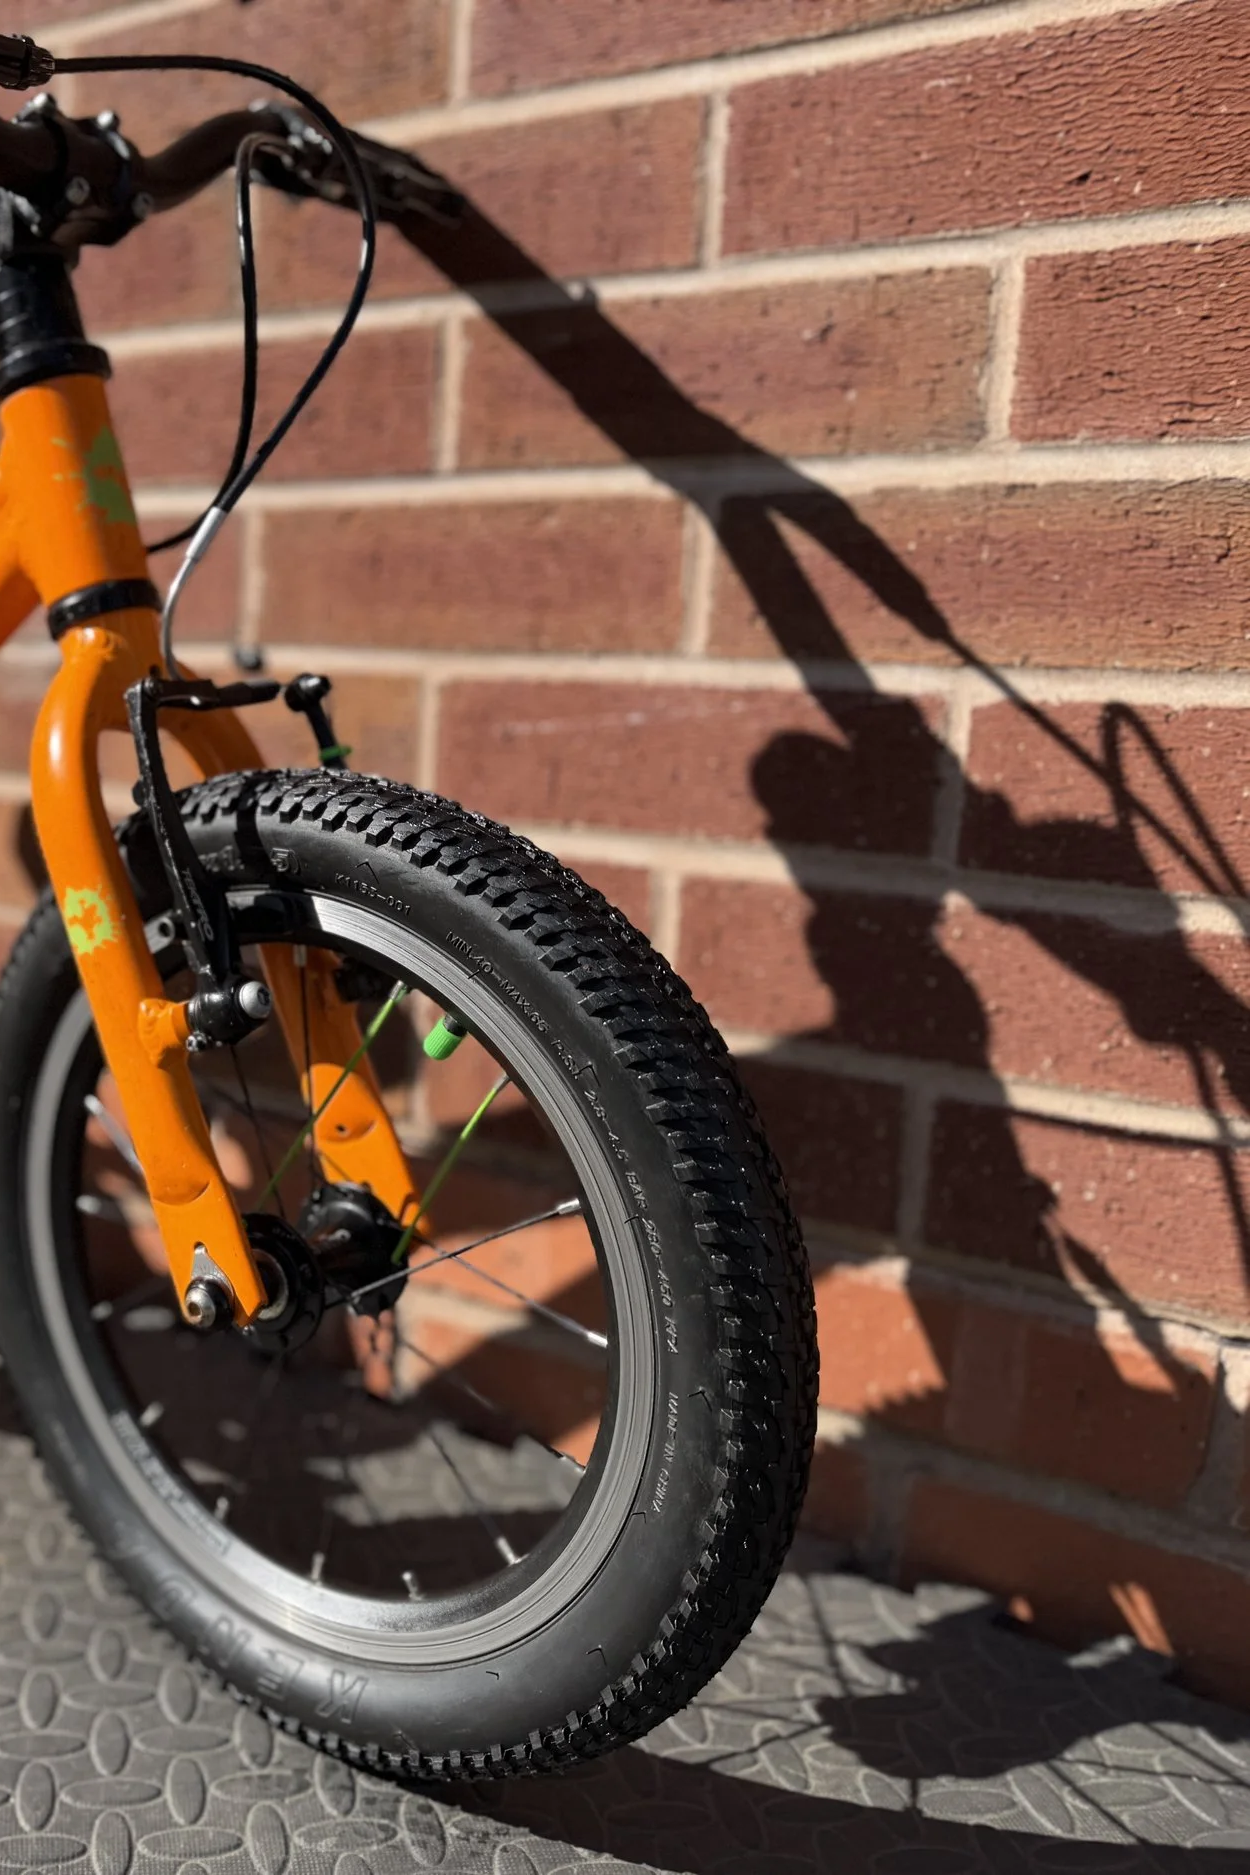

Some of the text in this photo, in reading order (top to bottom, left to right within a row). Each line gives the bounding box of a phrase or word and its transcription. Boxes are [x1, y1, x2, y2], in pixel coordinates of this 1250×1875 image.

[181, 867, 215, 941] TEKTRO
[665, 1391, 680, 1441] MADE
[651, 1467, 672, 1514] CHINA
